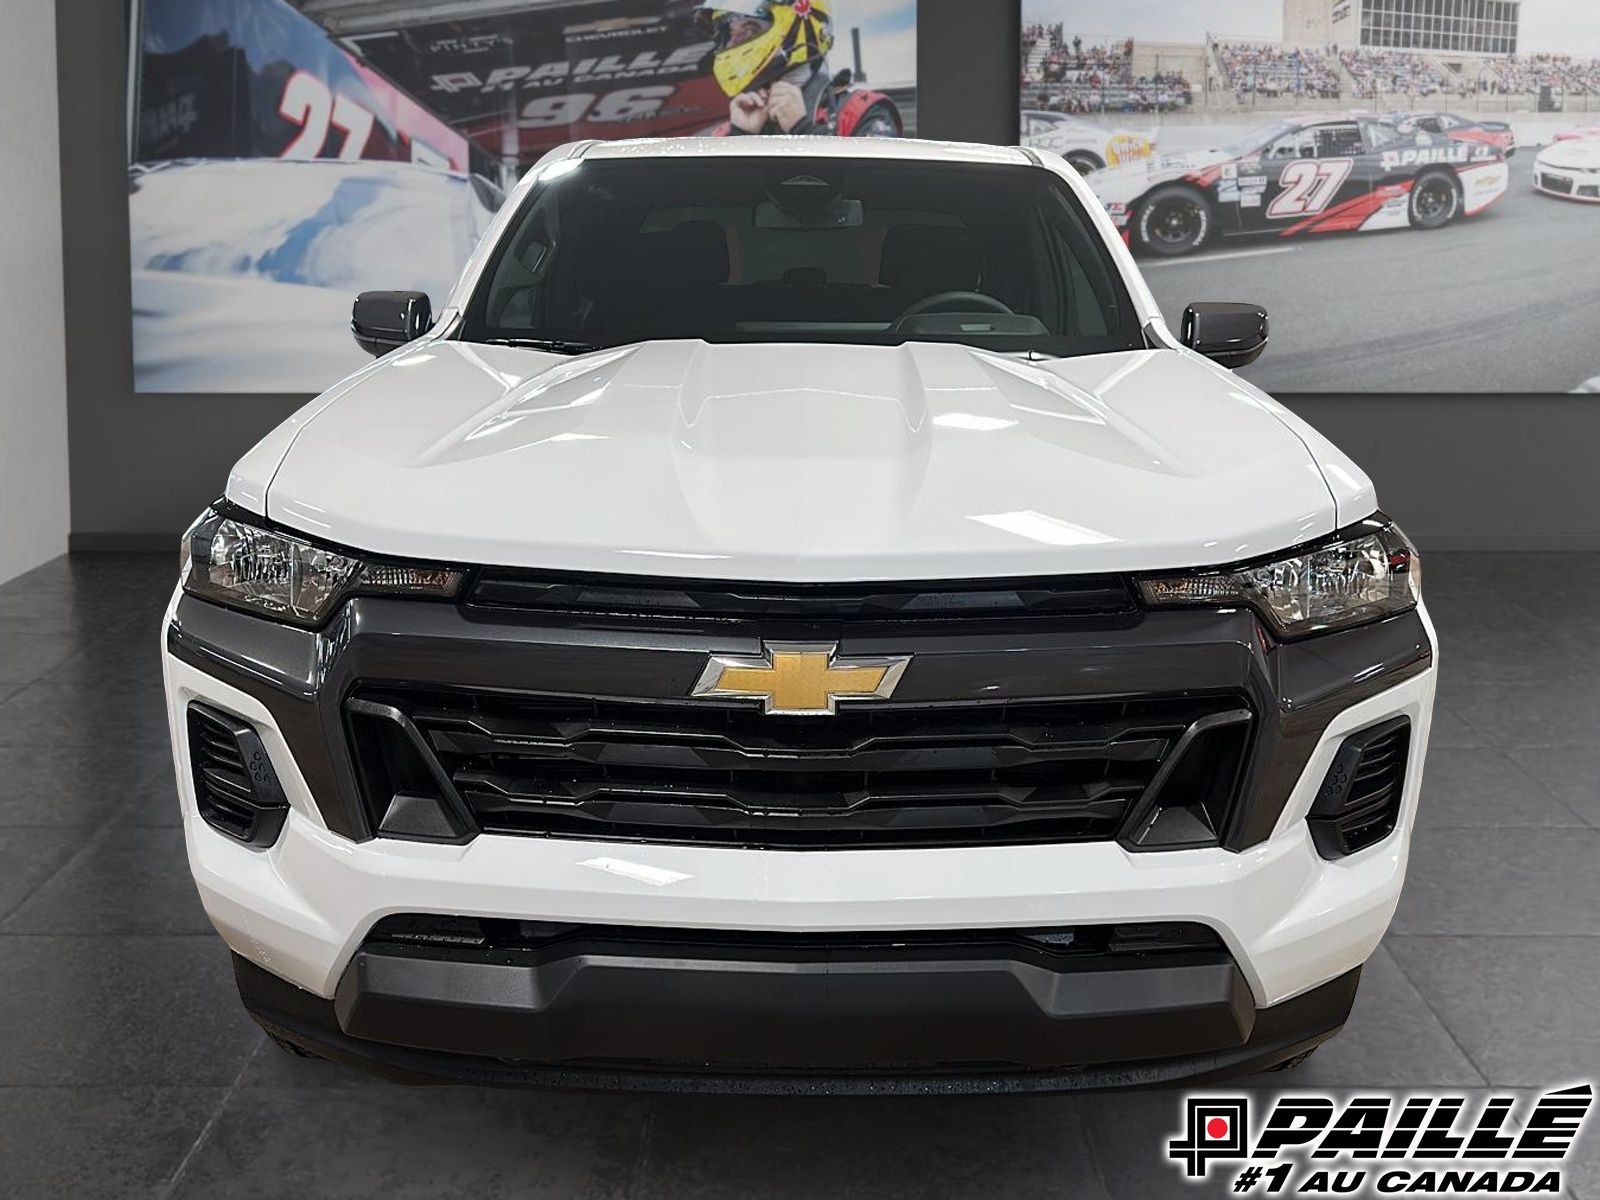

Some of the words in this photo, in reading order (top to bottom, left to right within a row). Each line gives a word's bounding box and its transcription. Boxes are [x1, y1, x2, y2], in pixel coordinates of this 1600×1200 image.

[565, 25, 668, 43] CHEVROLET
[523, 77, 563, 89] AU
[573, 64, 698, 83] CANADA
[279, 70, 375, 160] 27
[517, 85, 677, 129] 96
[1266, 157, 1354, 219] 27
